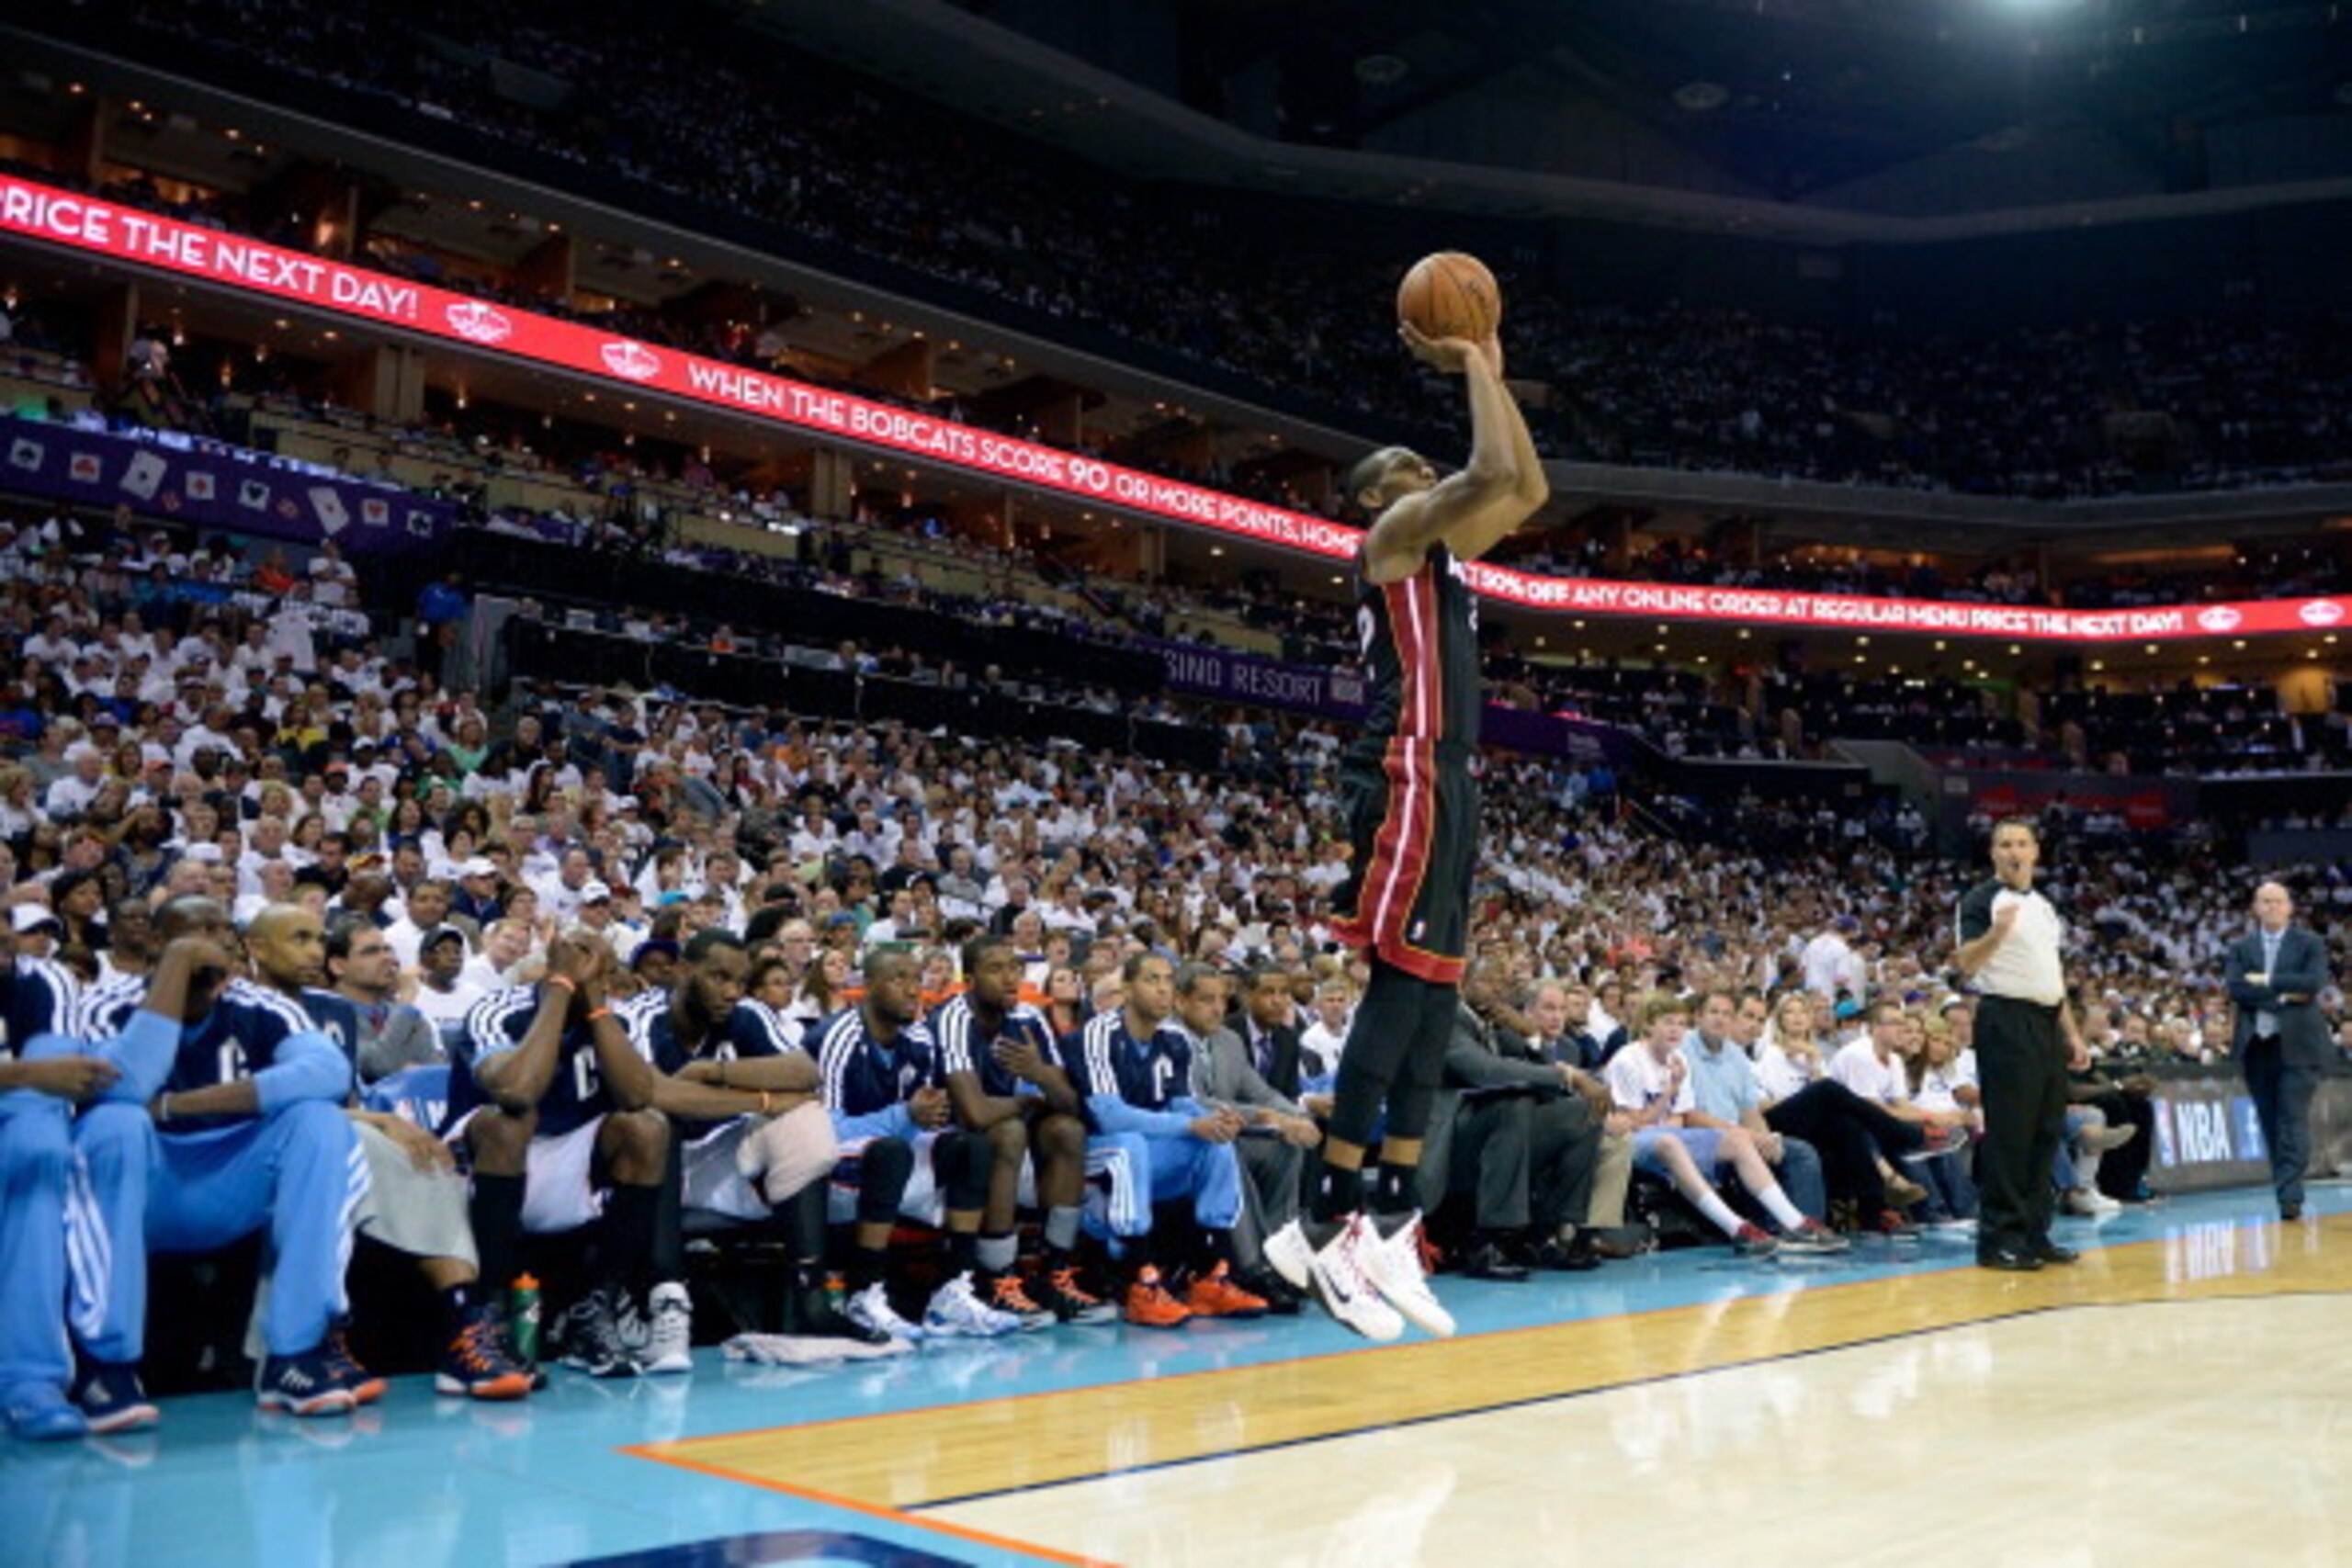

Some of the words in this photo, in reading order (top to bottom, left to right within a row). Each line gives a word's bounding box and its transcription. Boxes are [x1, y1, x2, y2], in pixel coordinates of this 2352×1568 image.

[0, 186, 110, 243] RICE
[122, 215, 207, 266] THE
[215, 242, 325, 294] NEXT
[332, 271, 420, 319] DAY!
[687, 363, 782, 409] WHEN
[788, 389, 845, 425] THE
[851, 405, 976, 458] BOBCATS
[981, 441, 1063, 480] SCORE
[1069, 458, 1110, 491] 90
[1115, 474, 1149, 503] OR
[1154, 487, 1219, 520] MORE
[1220, 498, 1300, 543] POINTS,
[1301, 522, 1361, 556] HOME
[1574, 585, 1618, 605] ANY
[1622, 587, 1705, 612] ONLINE
[1709, 592, 1782, 615] ORDER
[1784, 596, 1810, 619] AT
[1232, 664, 1323, 705] RESORT
[2177, 1100, 2233, 1163] NBA
